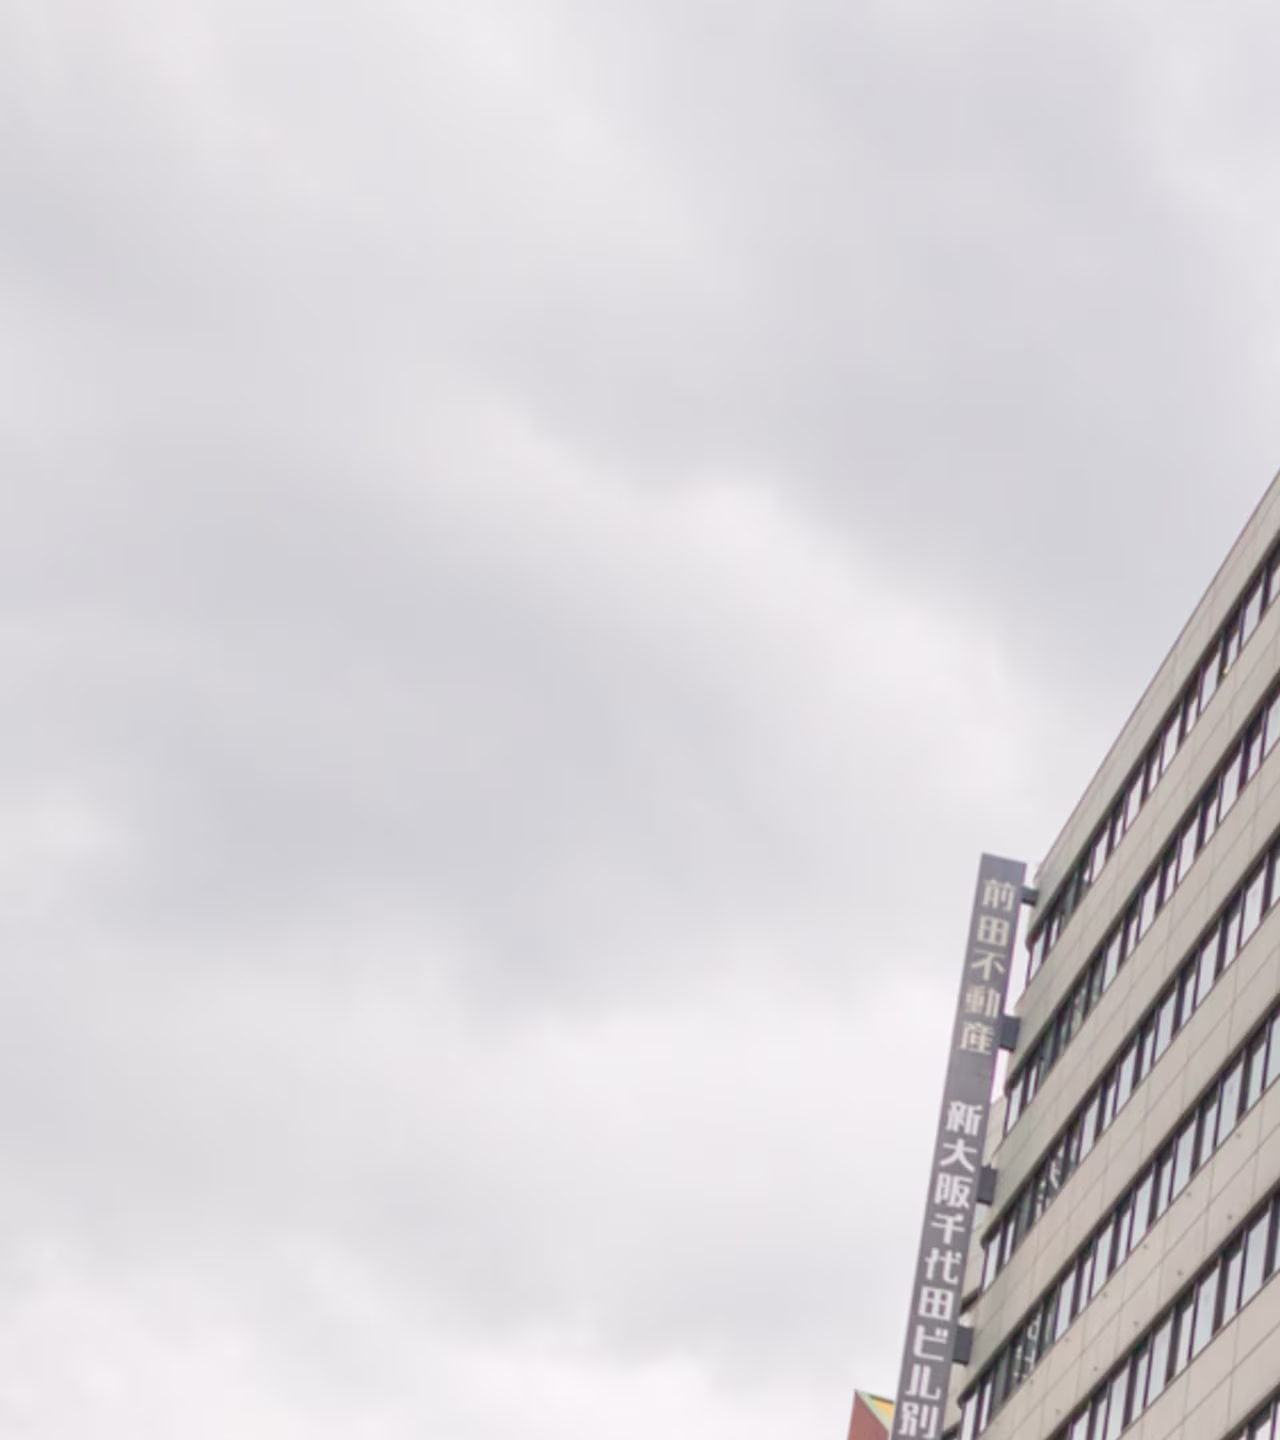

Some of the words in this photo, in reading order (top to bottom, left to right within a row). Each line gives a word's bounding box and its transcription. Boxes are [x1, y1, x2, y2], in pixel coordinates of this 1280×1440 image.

[958, 877, 1017, 1056] 前田不動産
